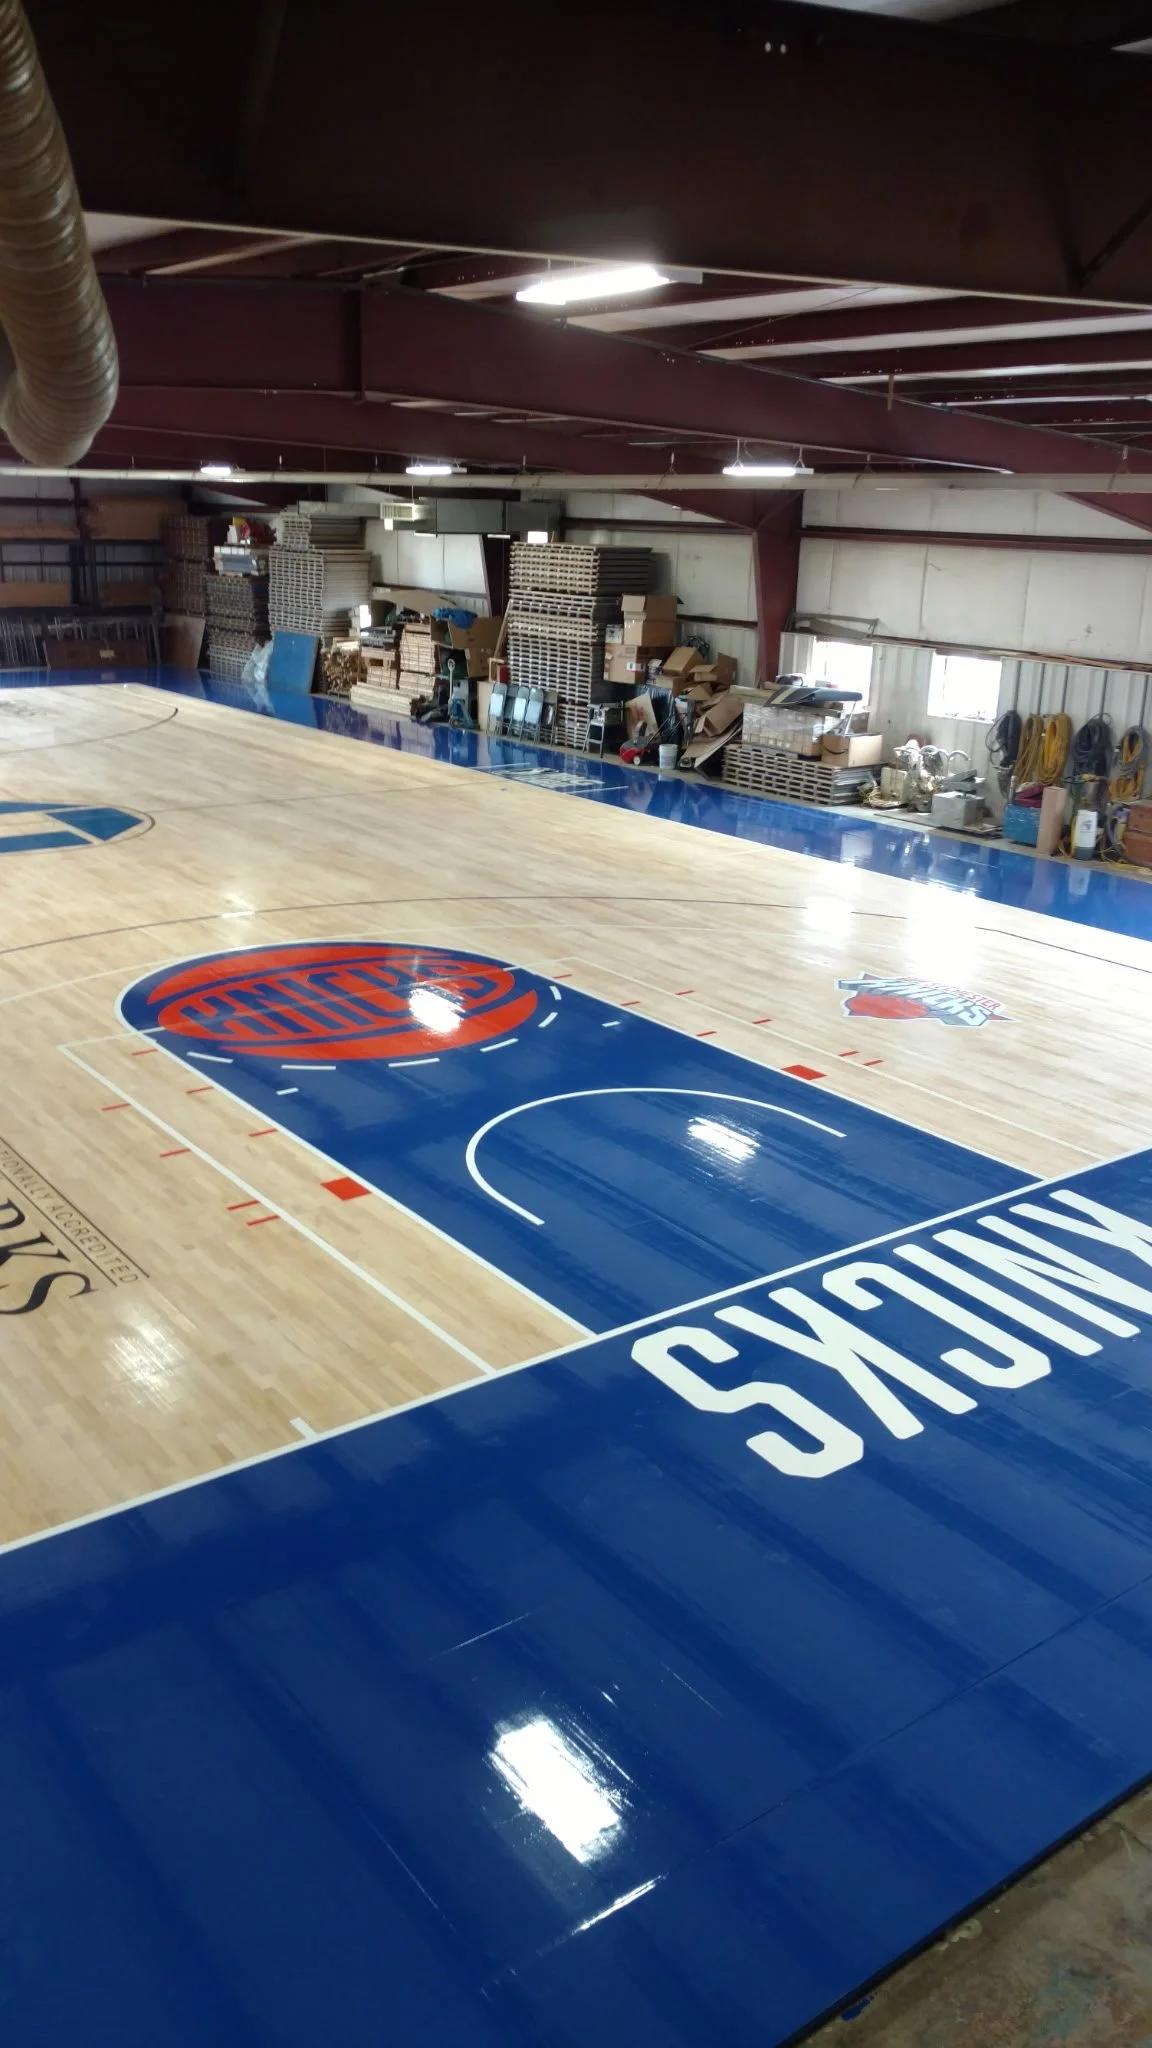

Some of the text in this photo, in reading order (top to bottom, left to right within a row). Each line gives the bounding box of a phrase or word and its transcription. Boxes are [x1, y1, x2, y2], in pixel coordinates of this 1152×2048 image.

[179, 963, 500, 1035] KNICKS
[838, 979, 991, 1026] KNICKS
[45, 1203, 139, 1285] ACCREDITED
